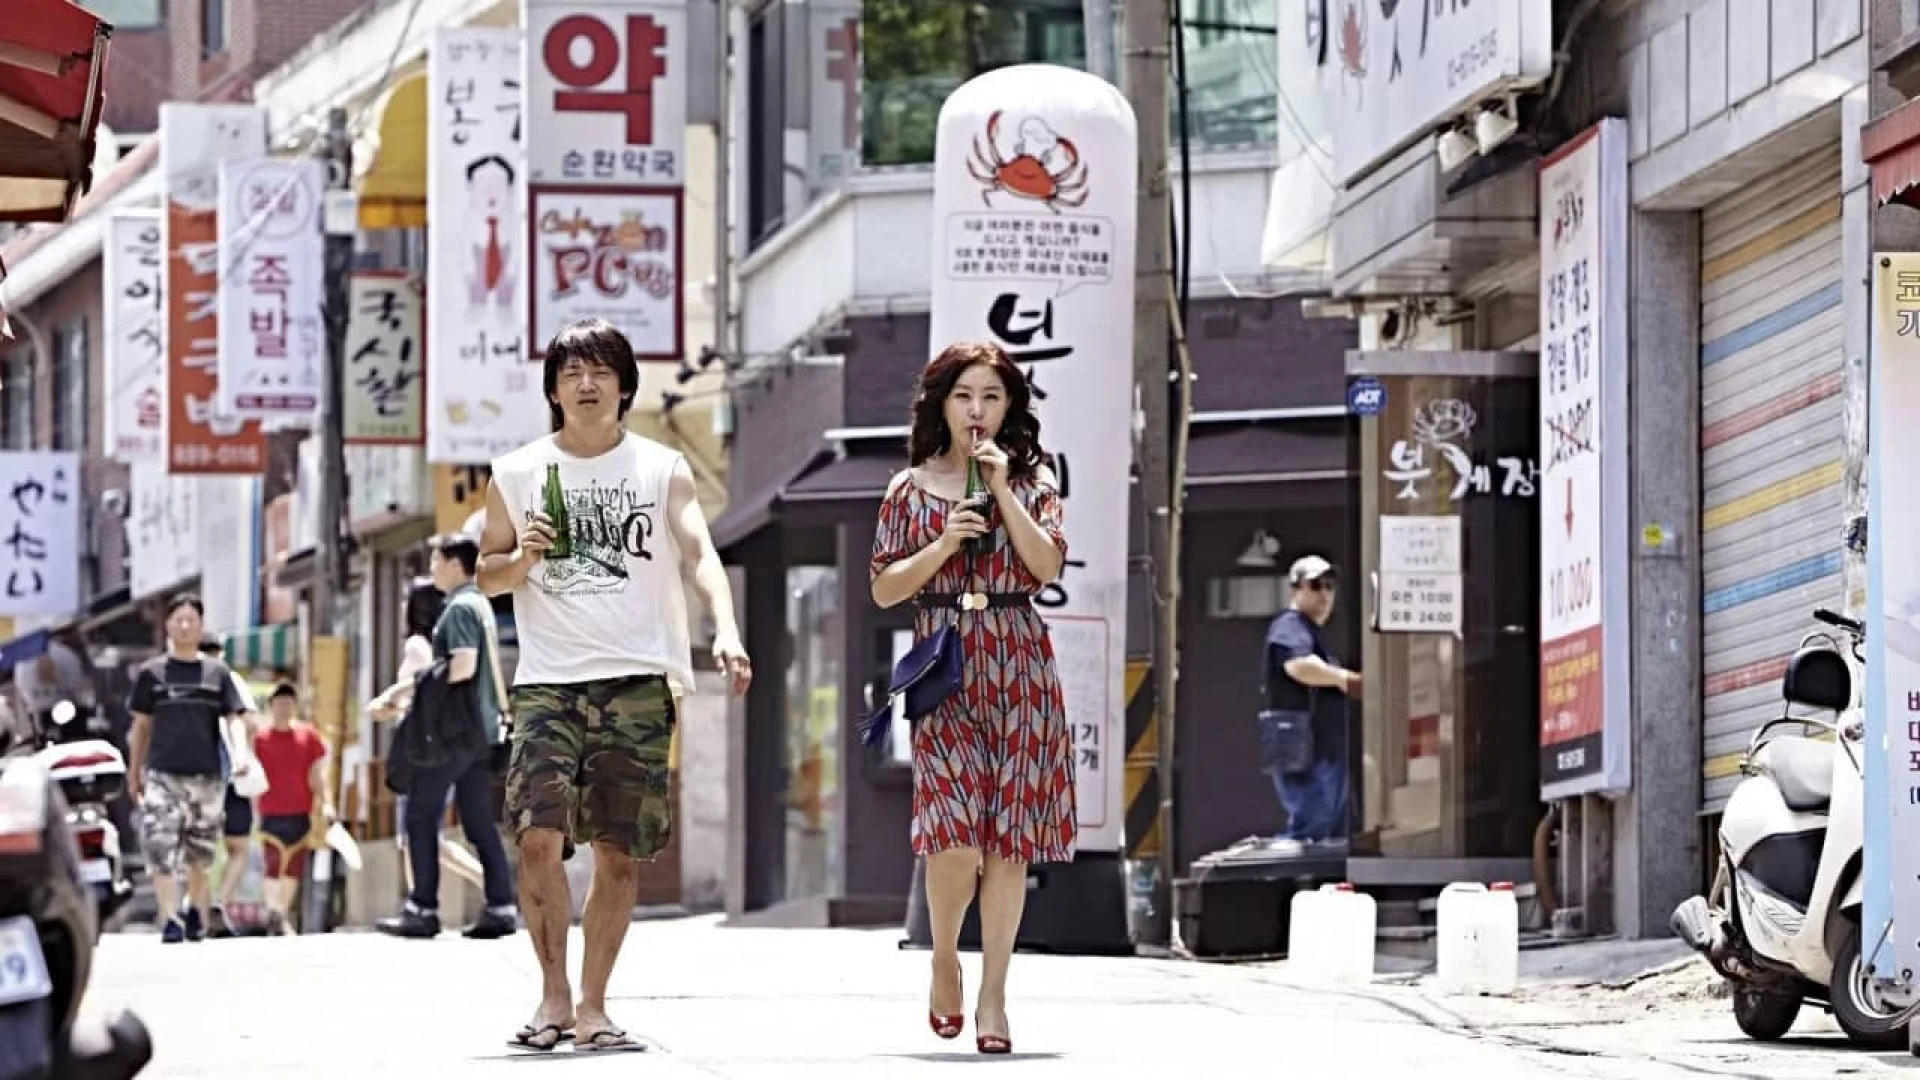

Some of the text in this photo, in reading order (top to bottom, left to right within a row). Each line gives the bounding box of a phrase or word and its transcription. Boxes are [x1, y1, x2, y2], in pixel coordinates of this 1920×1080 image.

[542, 13, 667, 146] 약
[562, 150, 677, 179] 순환약국
[249, 253, 292, 359] 족발
[5, 475, 48, 598] やたい
[1419, 611, 1453, 624] 24:00
[1420, 591, 1453, 604] 10:00
[1551, 556, 1592, 620] 10,000
